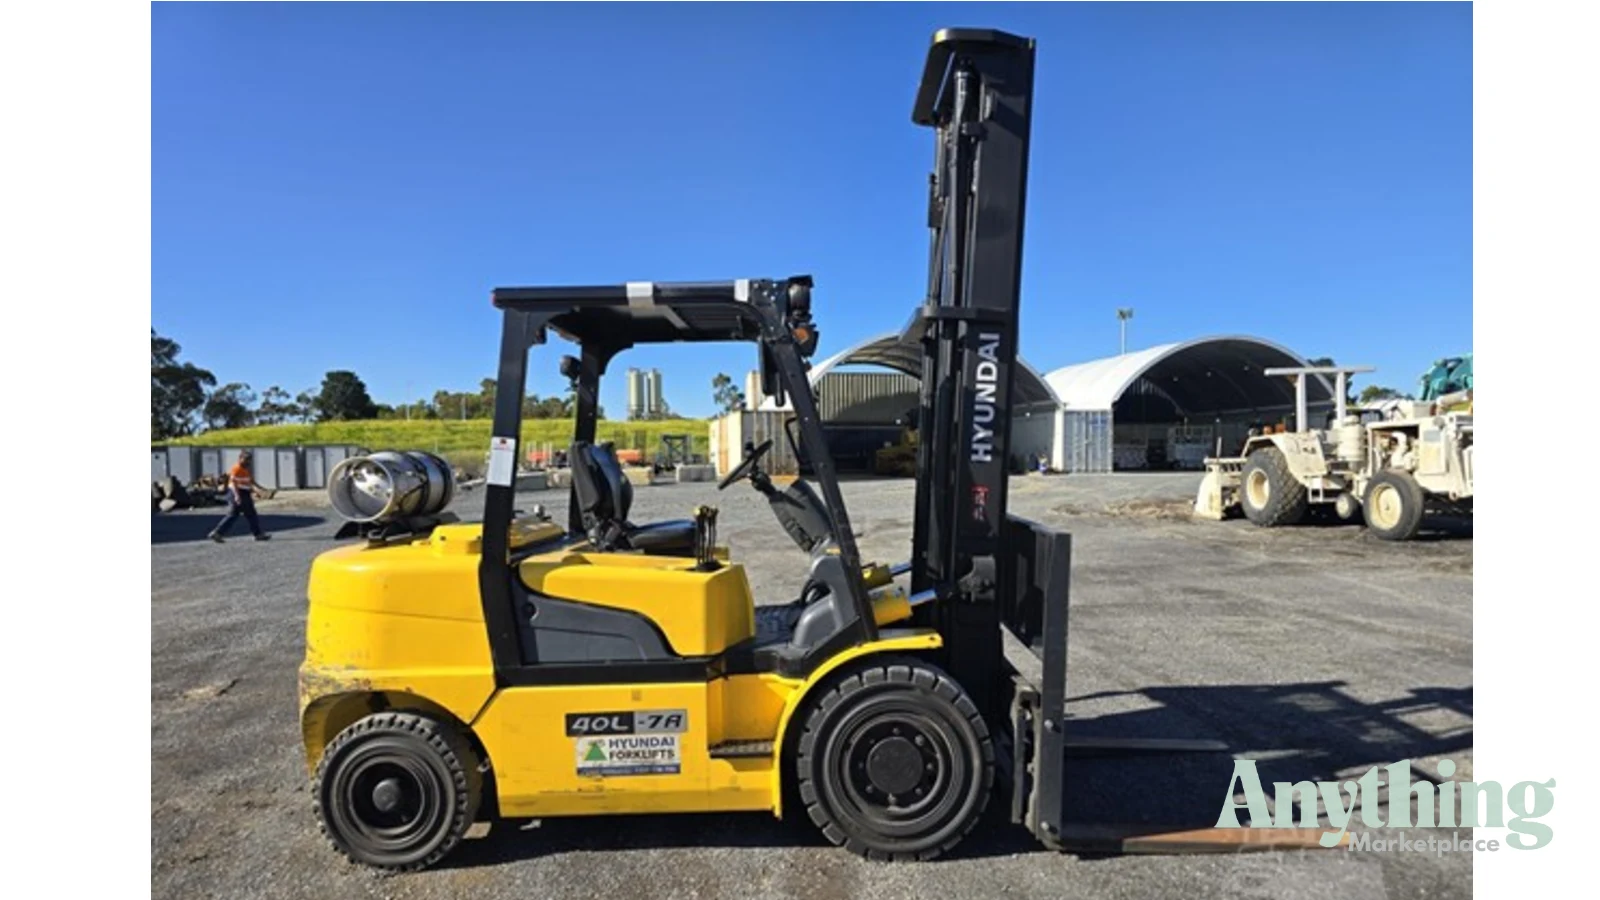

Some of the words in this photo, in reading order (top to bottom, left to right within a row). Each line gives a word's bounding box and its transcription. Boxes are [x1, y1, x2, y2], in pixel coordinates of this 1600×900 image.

[970, 332, 1000, 462] HYUNDAI
[609, 737, 675, 749] HYUNDAI
[609, 749, 675, 760] FORKLIFTS
